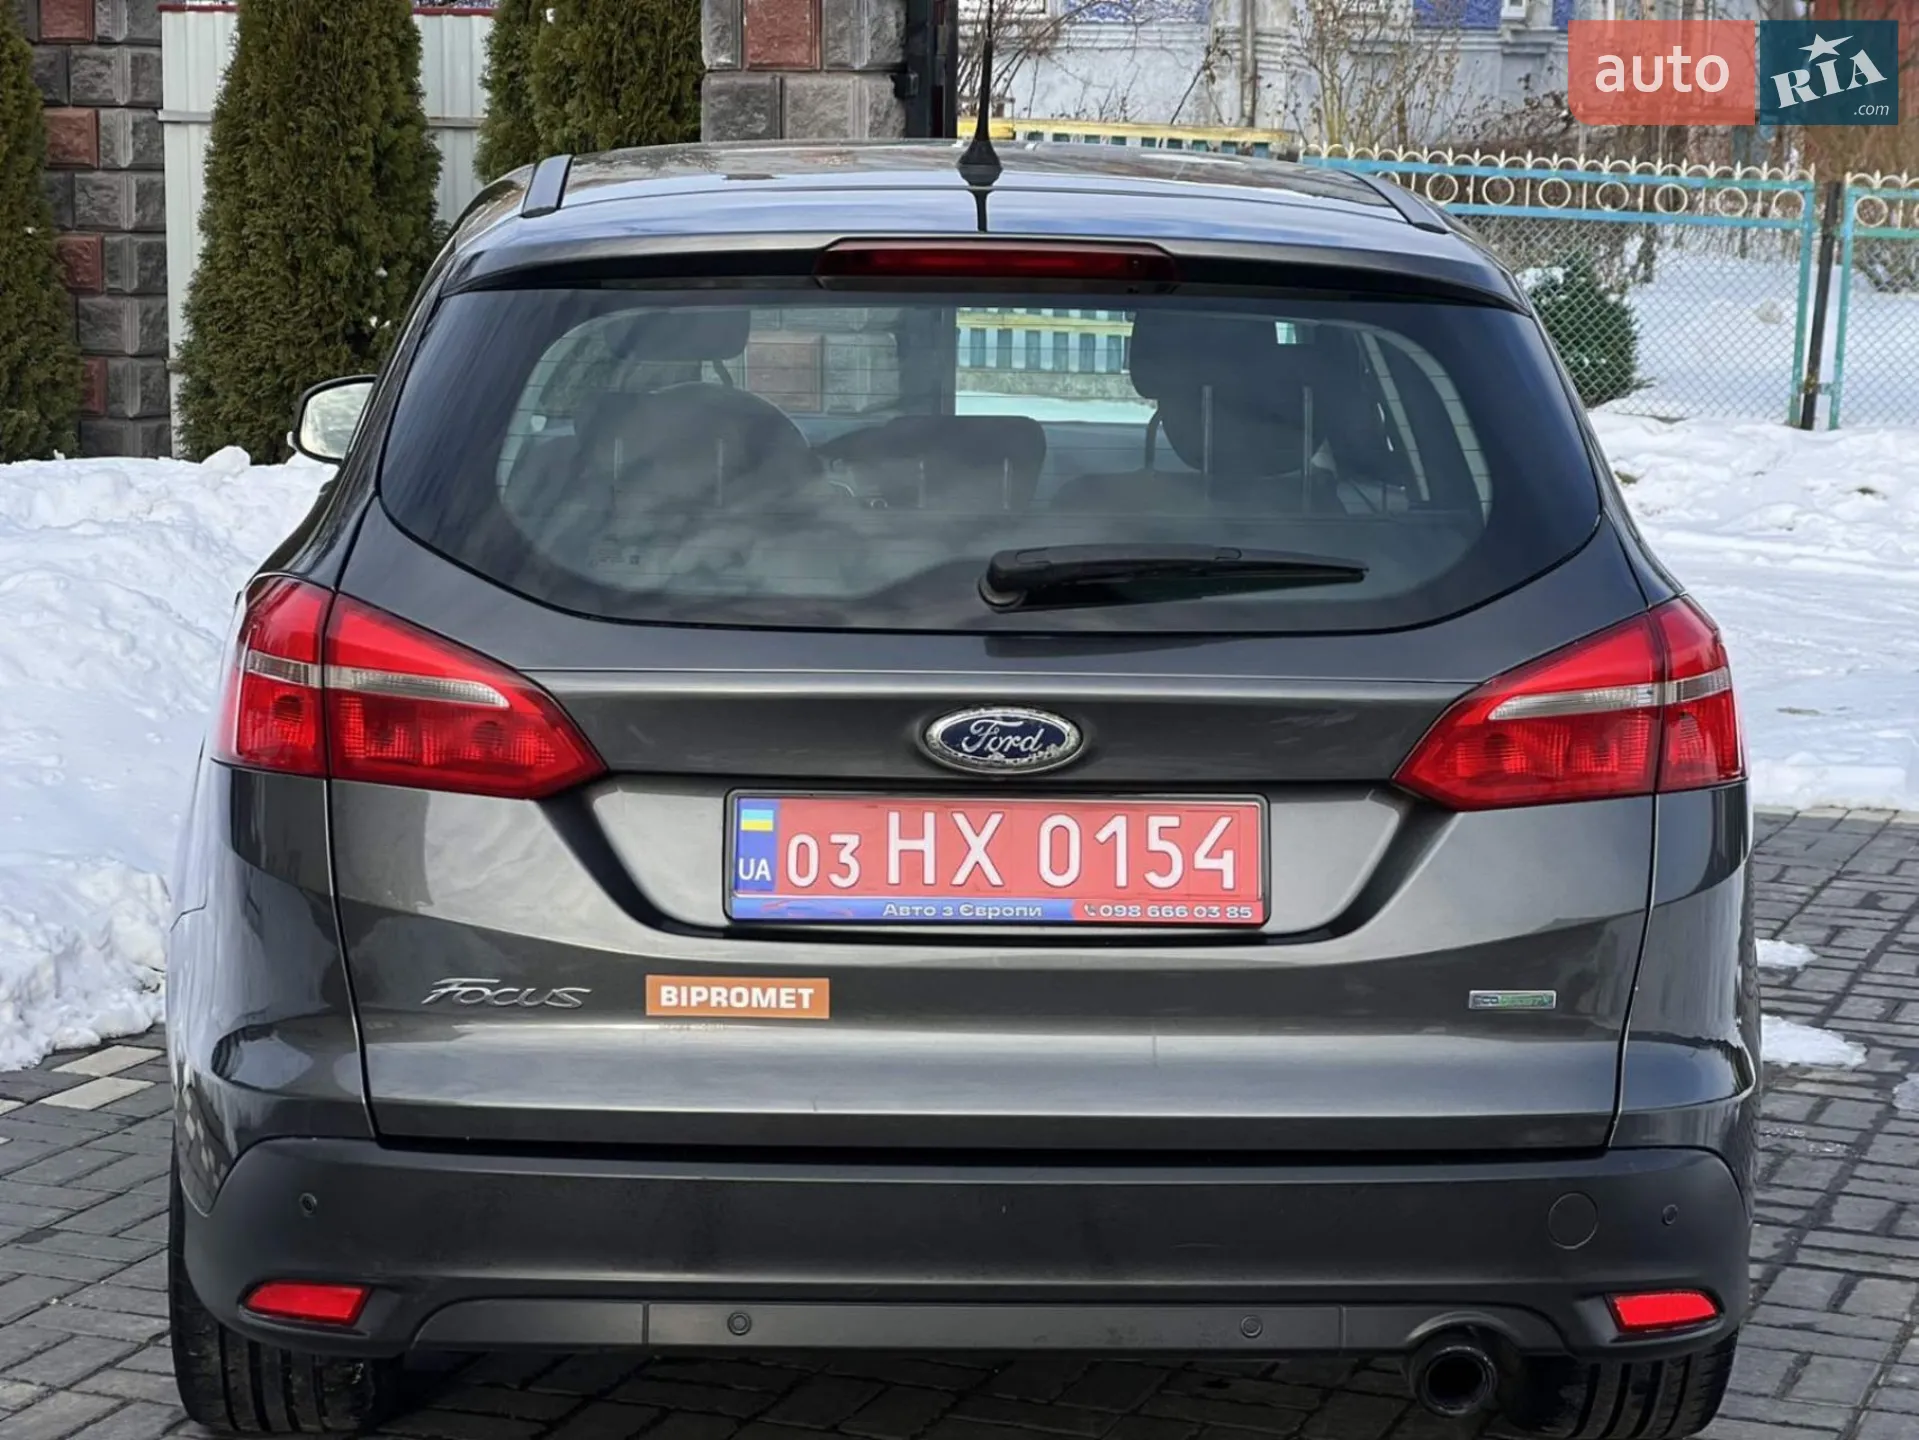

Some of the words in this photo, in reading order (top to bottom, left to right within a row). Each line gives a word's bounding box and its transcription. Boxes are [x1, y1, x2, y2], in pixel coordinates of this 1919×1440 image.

[962, 719, 1045, 753] Ford
[786, 833, 861, 889] 03
[1037, 814, 1235, 890] 0154
[739, 859, 771, 882] UA
[882, 903, 937, 918] Авто
[942, 906, 954, 917] з
[959, 902, 1042, 919] Європи
[1099, 904, 1141, 918] 098
[1147, 904, 1189, 918] 666
[1193, 904, 1221, 918] 03
[1225, 905, 1253, 919] 85
[660, 984, 815, 1009] BIPROMET
